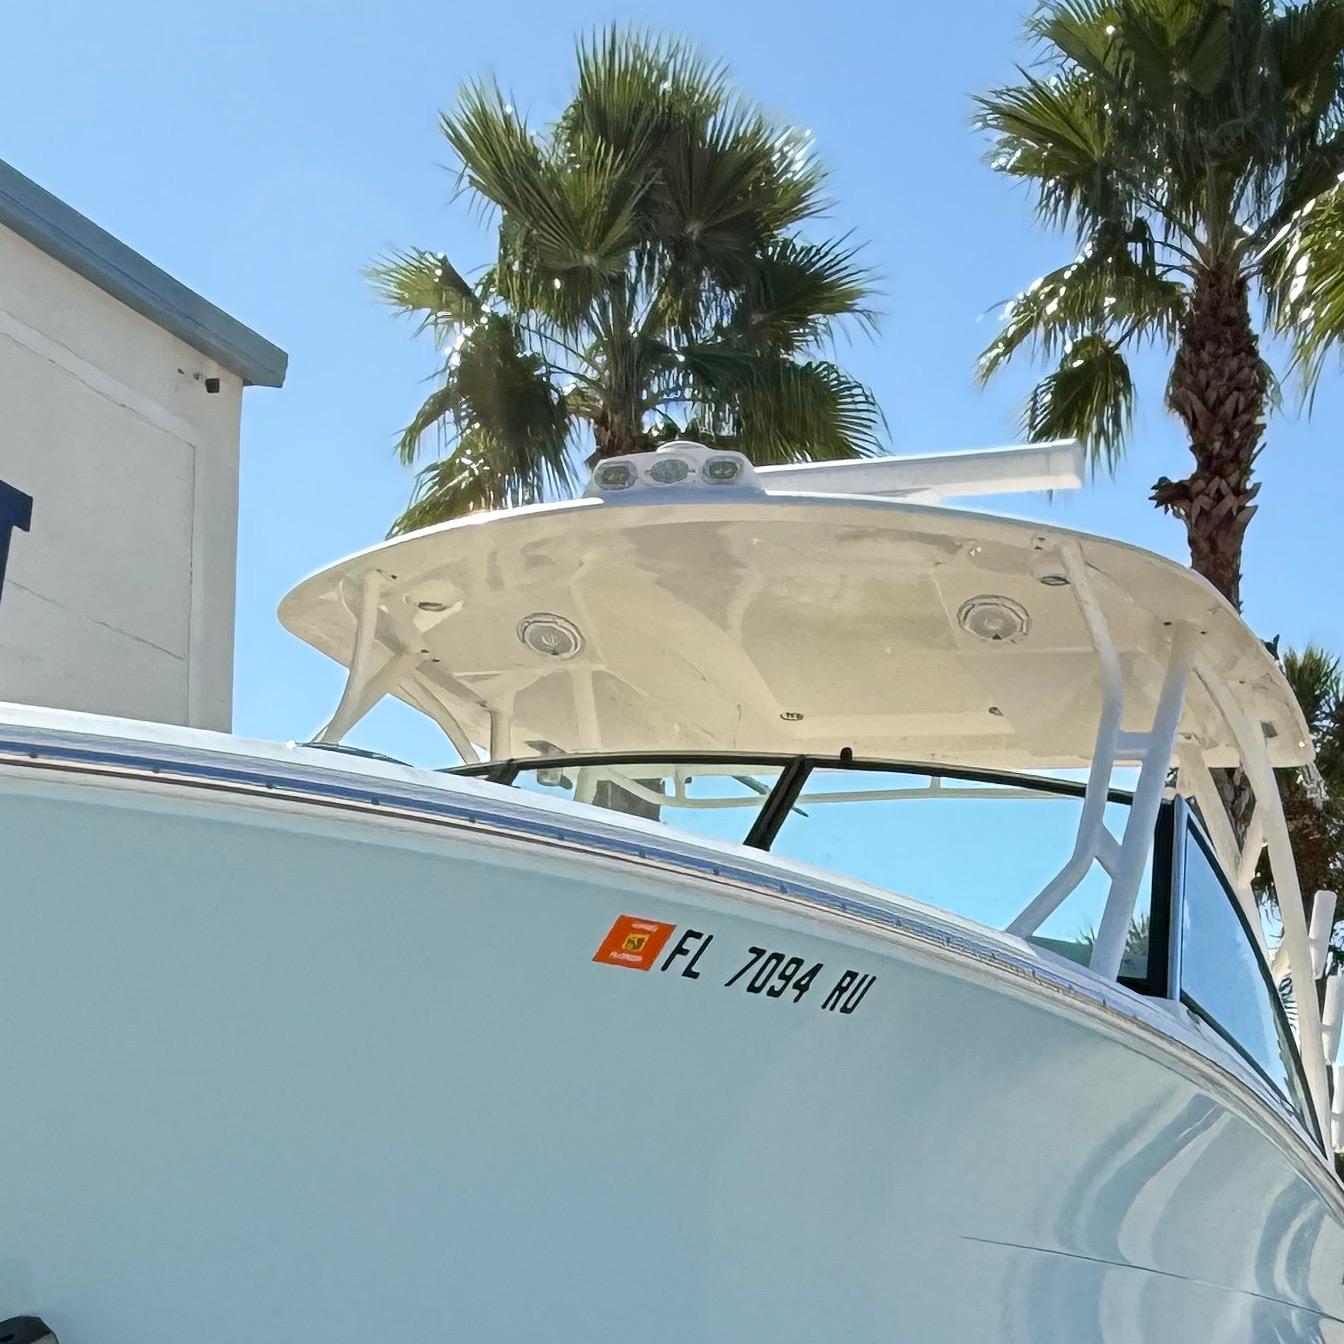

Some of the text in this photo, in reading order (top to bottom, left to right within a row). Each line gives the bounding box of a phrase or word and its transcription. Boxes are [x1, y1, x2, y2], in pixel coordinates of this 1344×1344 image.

[660, 929, 877, 1014] FL 7094 RU
